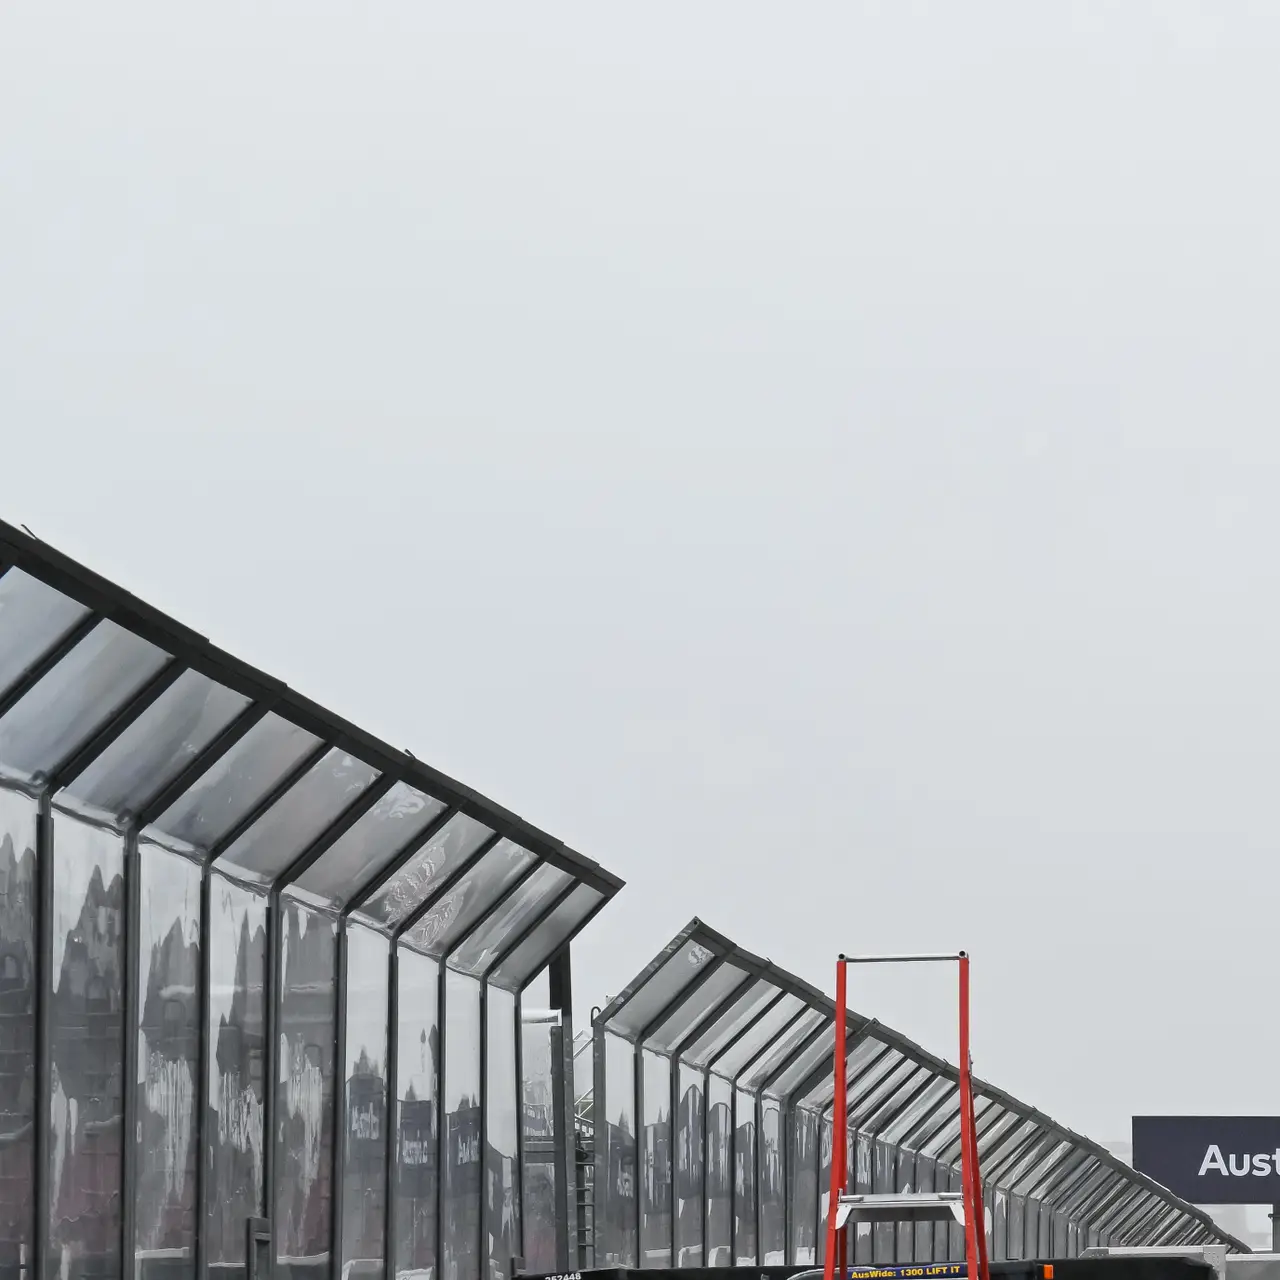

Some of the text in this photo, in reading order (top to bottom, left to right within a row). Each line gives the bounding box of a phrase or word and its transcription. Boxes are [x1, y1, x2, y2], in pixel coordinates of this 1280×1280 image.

[851, 1270, 896, 1279] AusWide:
[900, 1268, 923, 1276] 1300
[926, 1267, 947, 1275] LIFT
